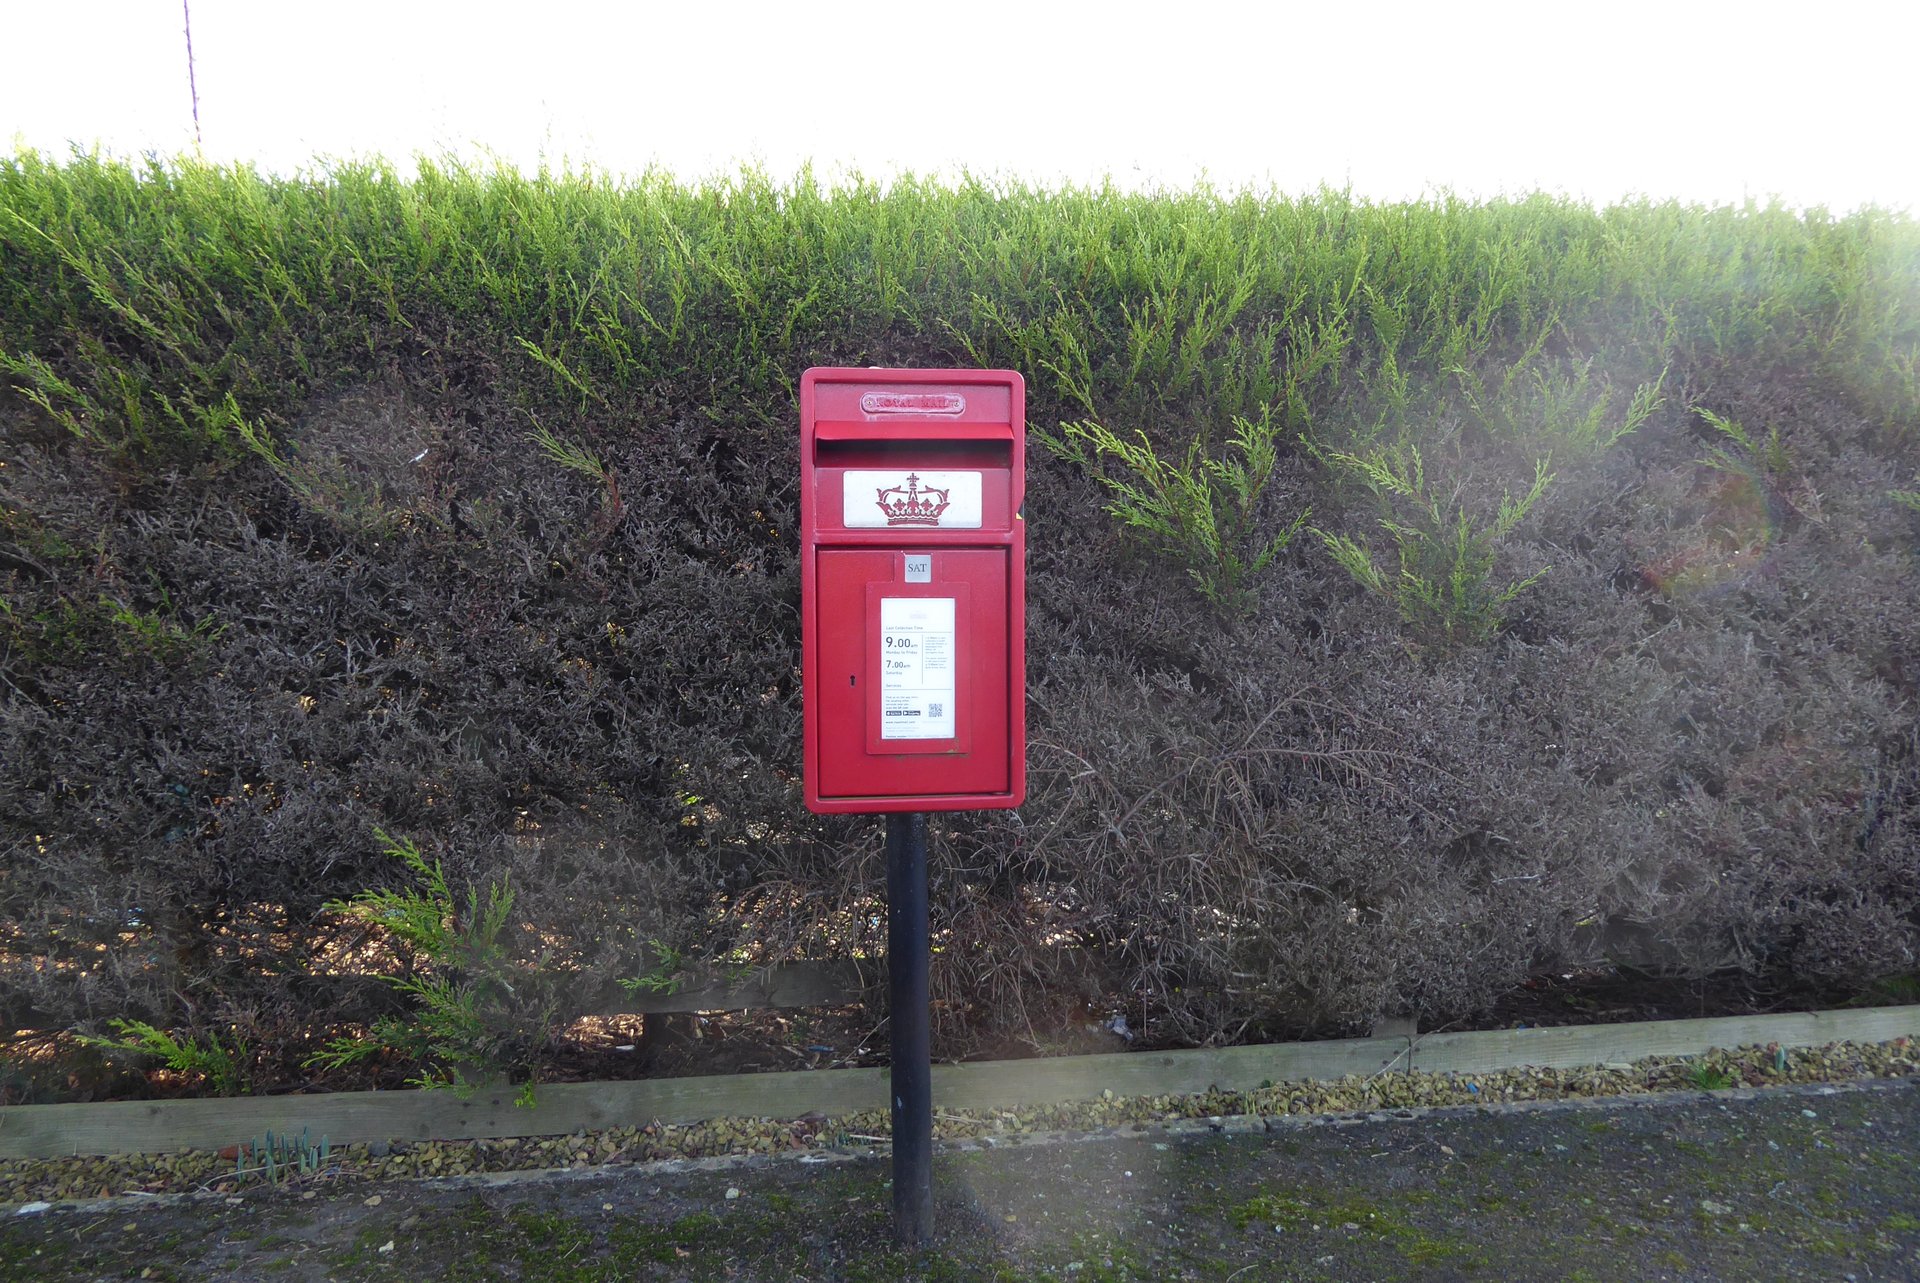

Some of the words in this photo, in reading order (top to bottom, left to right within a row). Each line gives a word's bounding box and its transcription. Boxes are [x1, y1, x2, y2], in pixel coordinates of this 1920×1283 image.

[876, 398, 914, 408] ROYAL
[920, 399, 949, 408] MAIL
[907, 563, 928, 573] SAT
